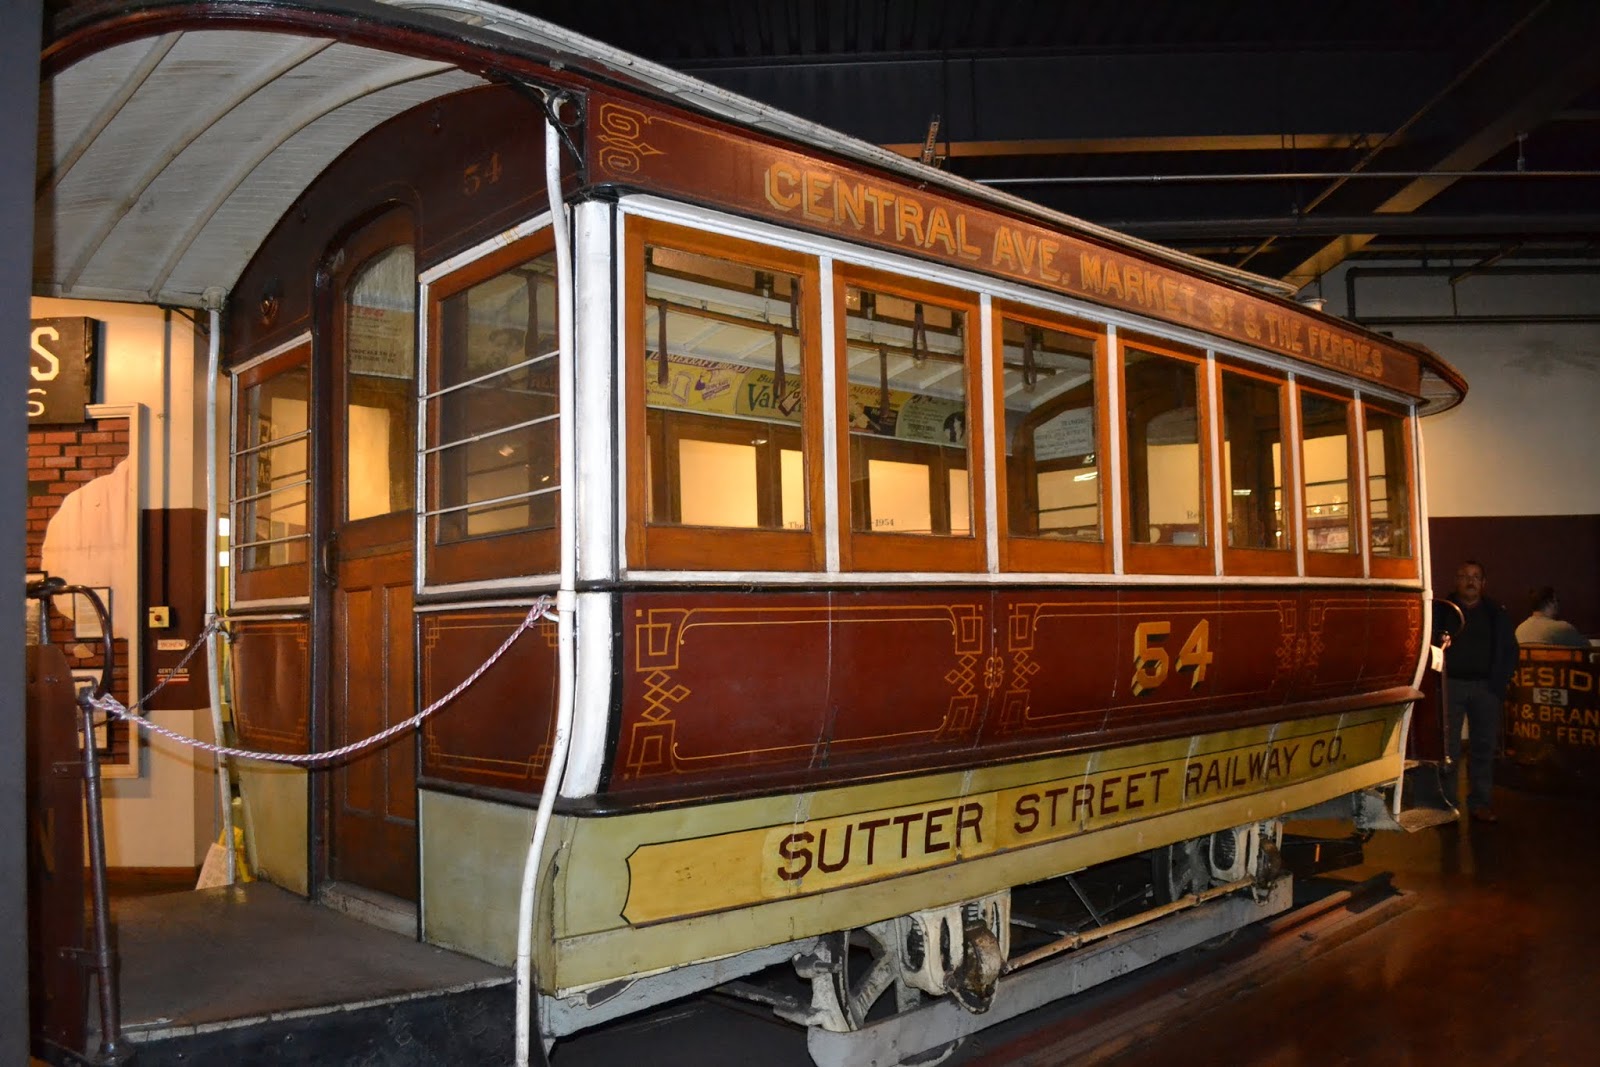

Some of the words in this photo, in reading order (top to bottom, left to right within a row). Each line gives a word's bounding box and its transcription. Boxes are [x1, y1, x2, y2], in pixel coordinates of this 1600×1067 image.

[463, 152, 502, 196] 54
[754, 160, 981, 262] CENTRAL
[1080, 252, 1196, 320] MARKET
[1244, 304, 1261, 341] &
[1264, 312, 1303, 353] THE
[1308, 325, 1384, 378] FERRIES
[1131, 618, 1213, 697] 54
[1521, 703, 1534, 720] &
[777, 802, 983, 882] SUTTER
[1014, 768, 1170, 834] STREET
[1185, 743, 1300, 797] RAILWAY
[1309, 736, 1347, 769] CO.
